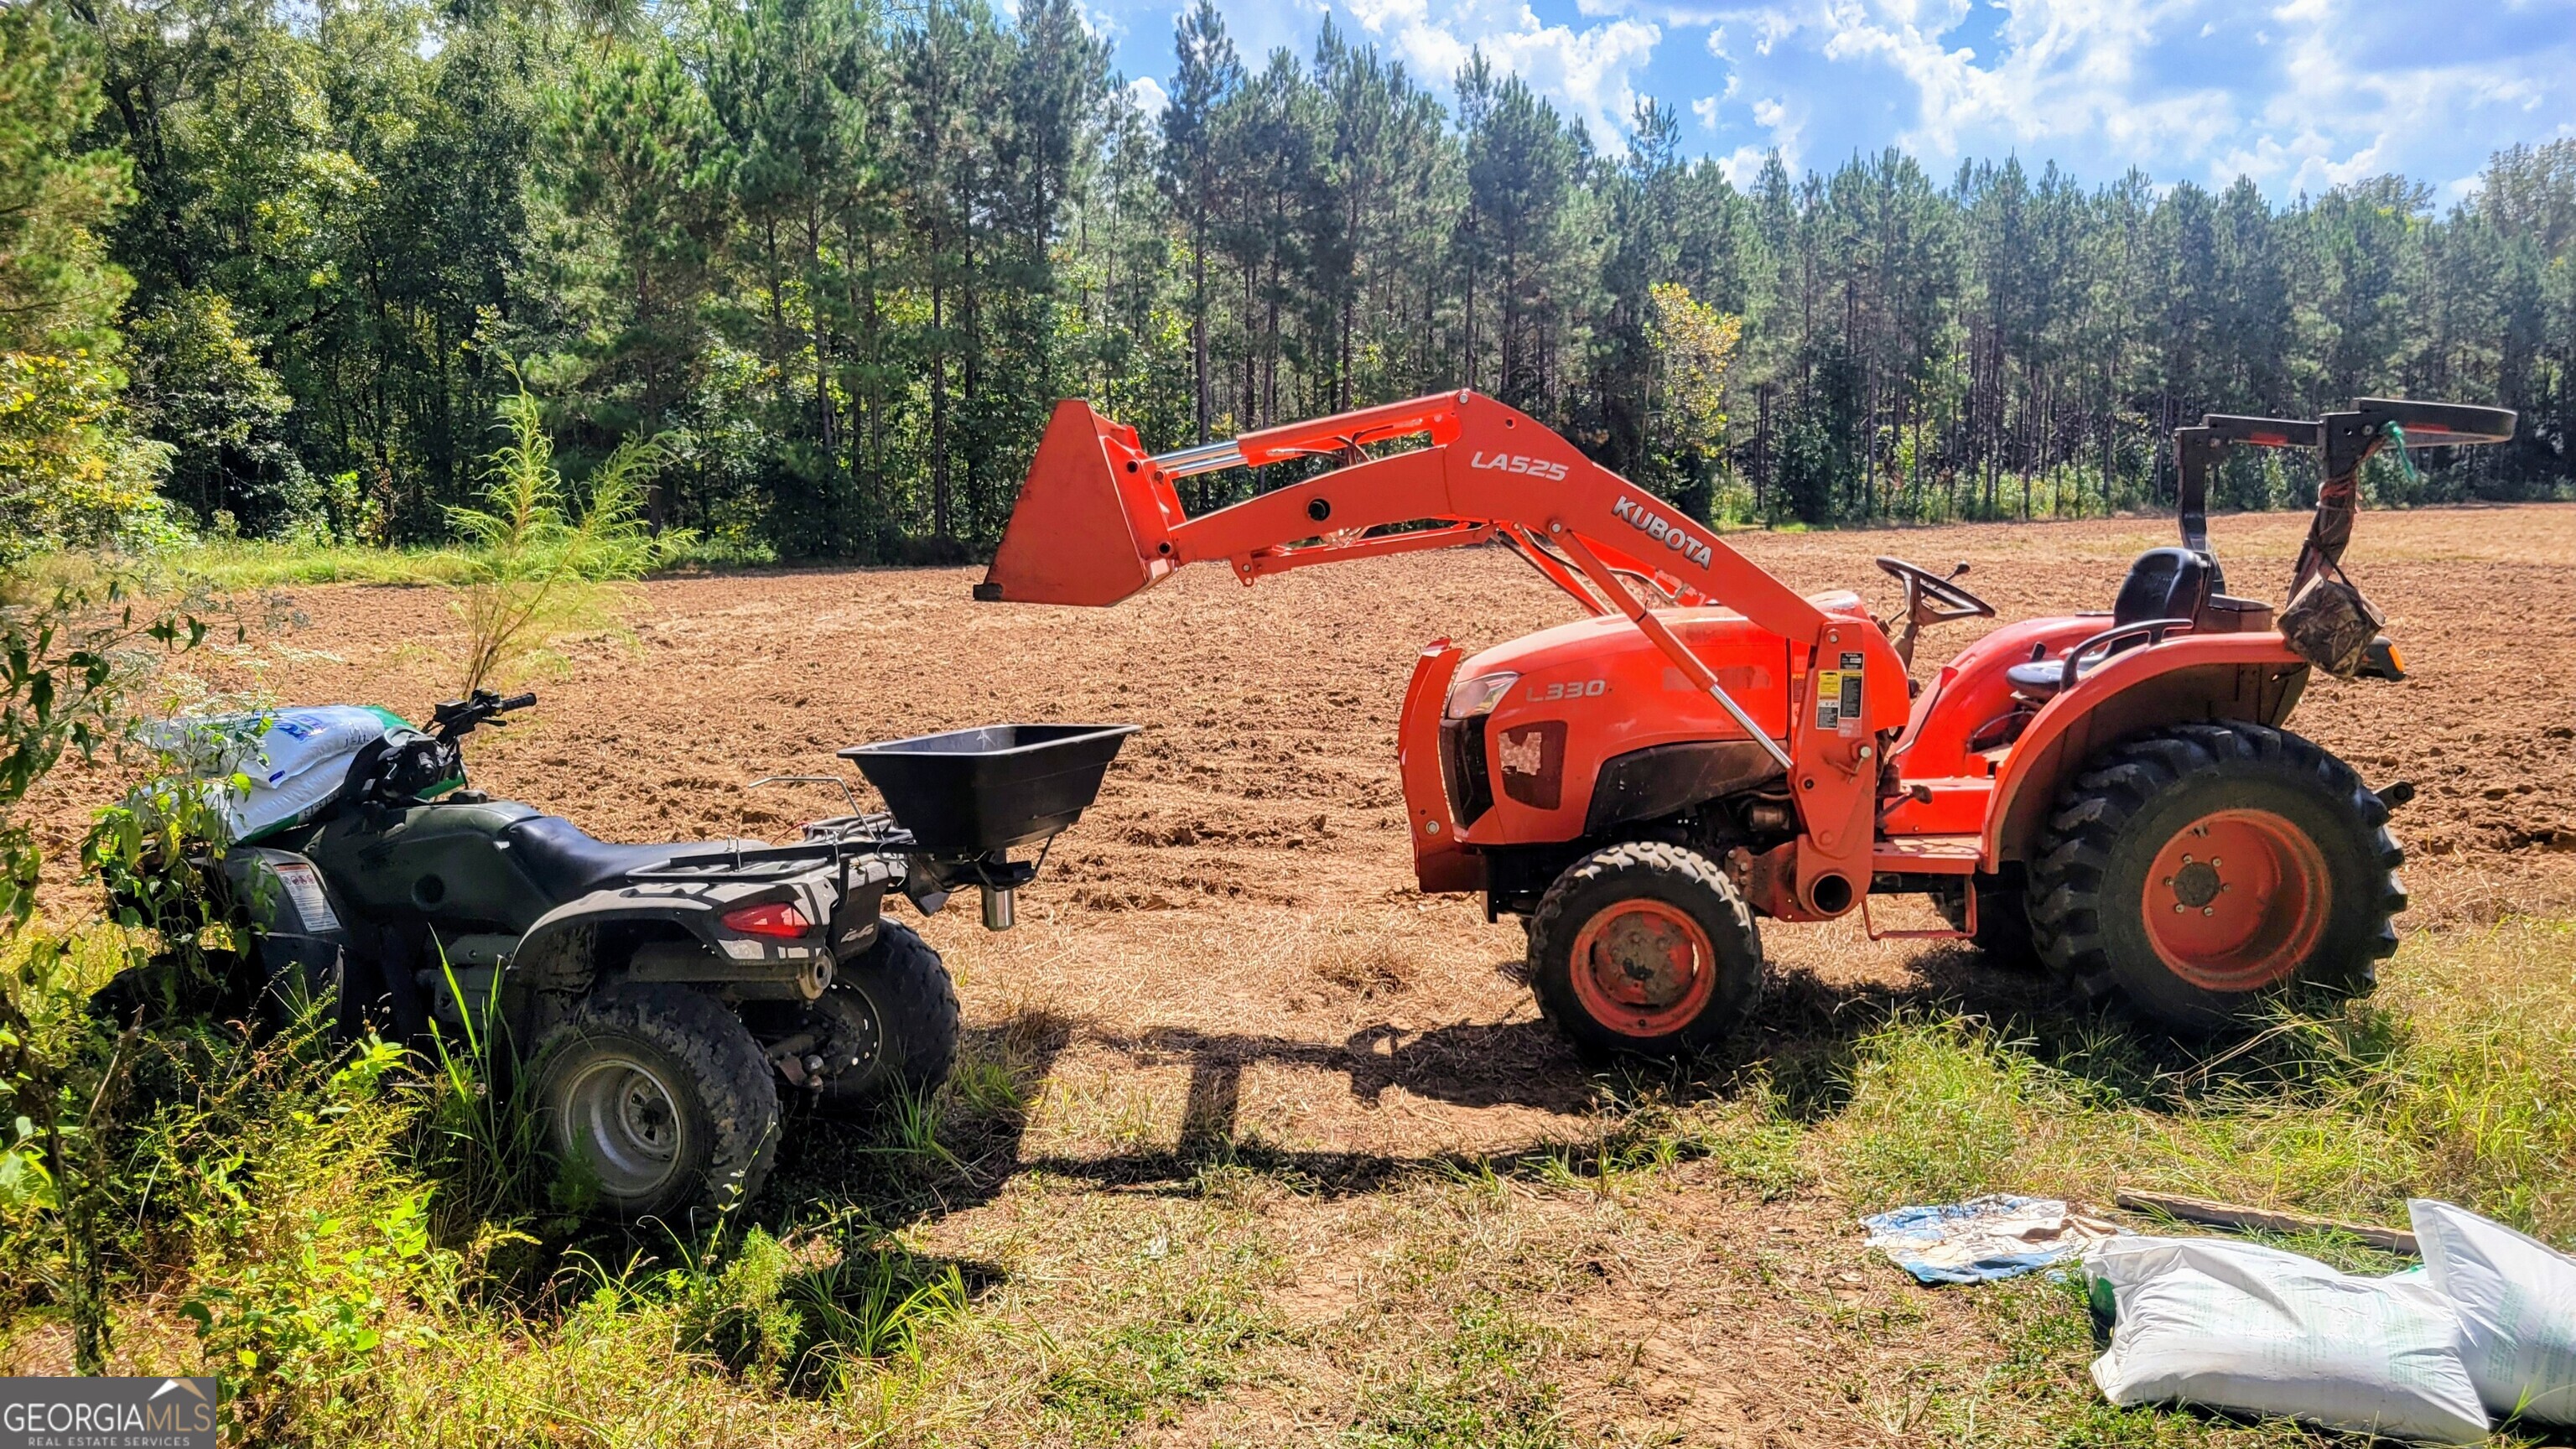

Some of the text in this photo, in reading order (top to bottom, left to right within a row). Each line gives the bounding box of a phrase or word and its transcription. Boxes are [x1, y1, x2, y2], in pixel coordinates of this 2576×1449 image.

[1471, 451, 1569, 481] LA525
[1611, 495, 1712, 570] KUBOTA
[1526, 679, 1606, 703] L330
